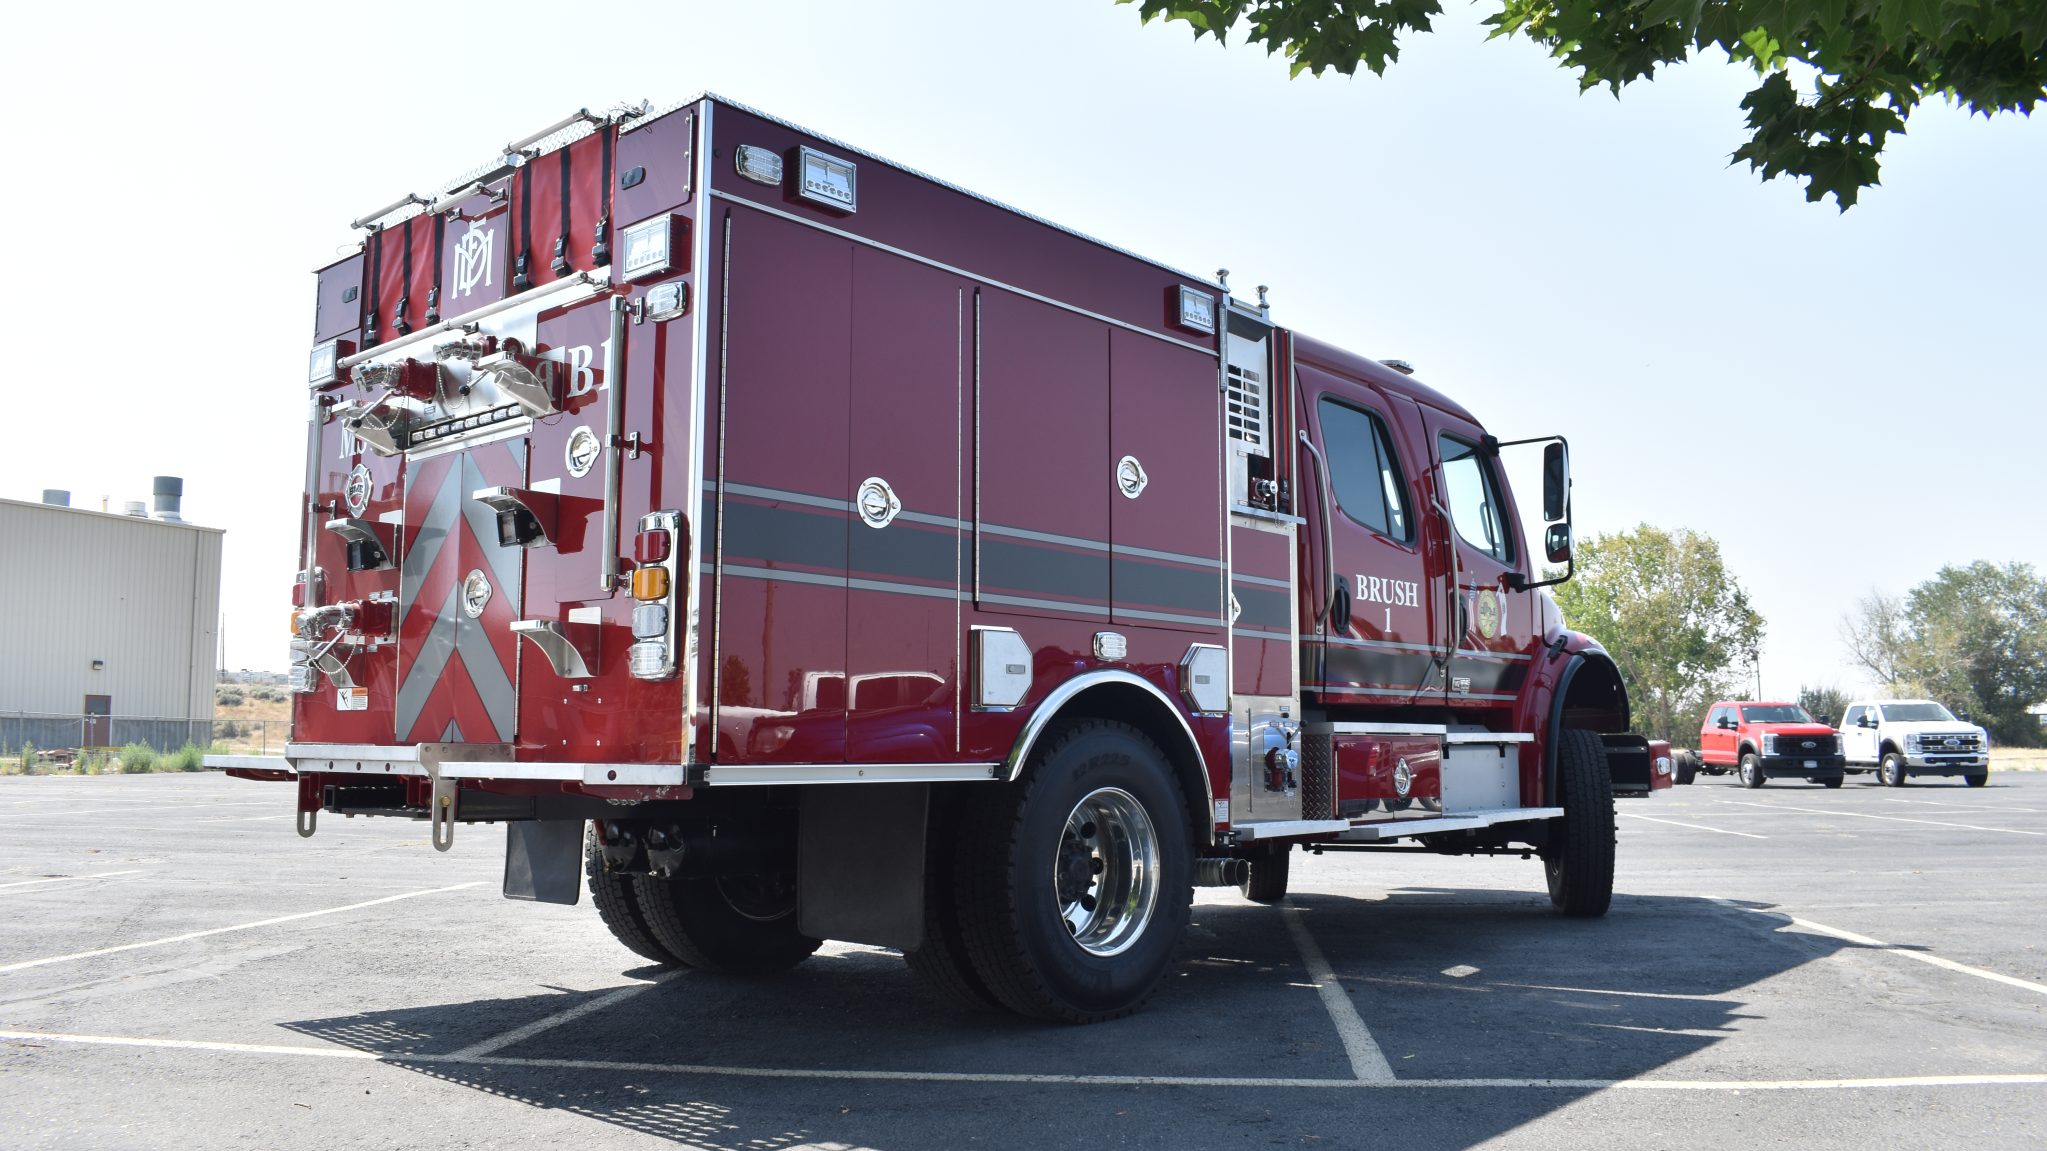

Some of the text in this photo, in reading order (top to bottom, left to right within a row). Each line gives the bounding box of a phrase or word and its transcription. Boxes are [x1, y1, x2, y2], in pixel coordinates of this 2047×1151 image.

[566, 336, 612, 399] B1
[1355, 574, 1419, 607] BRUSH
[1384, 608, 1392, 633] 1
